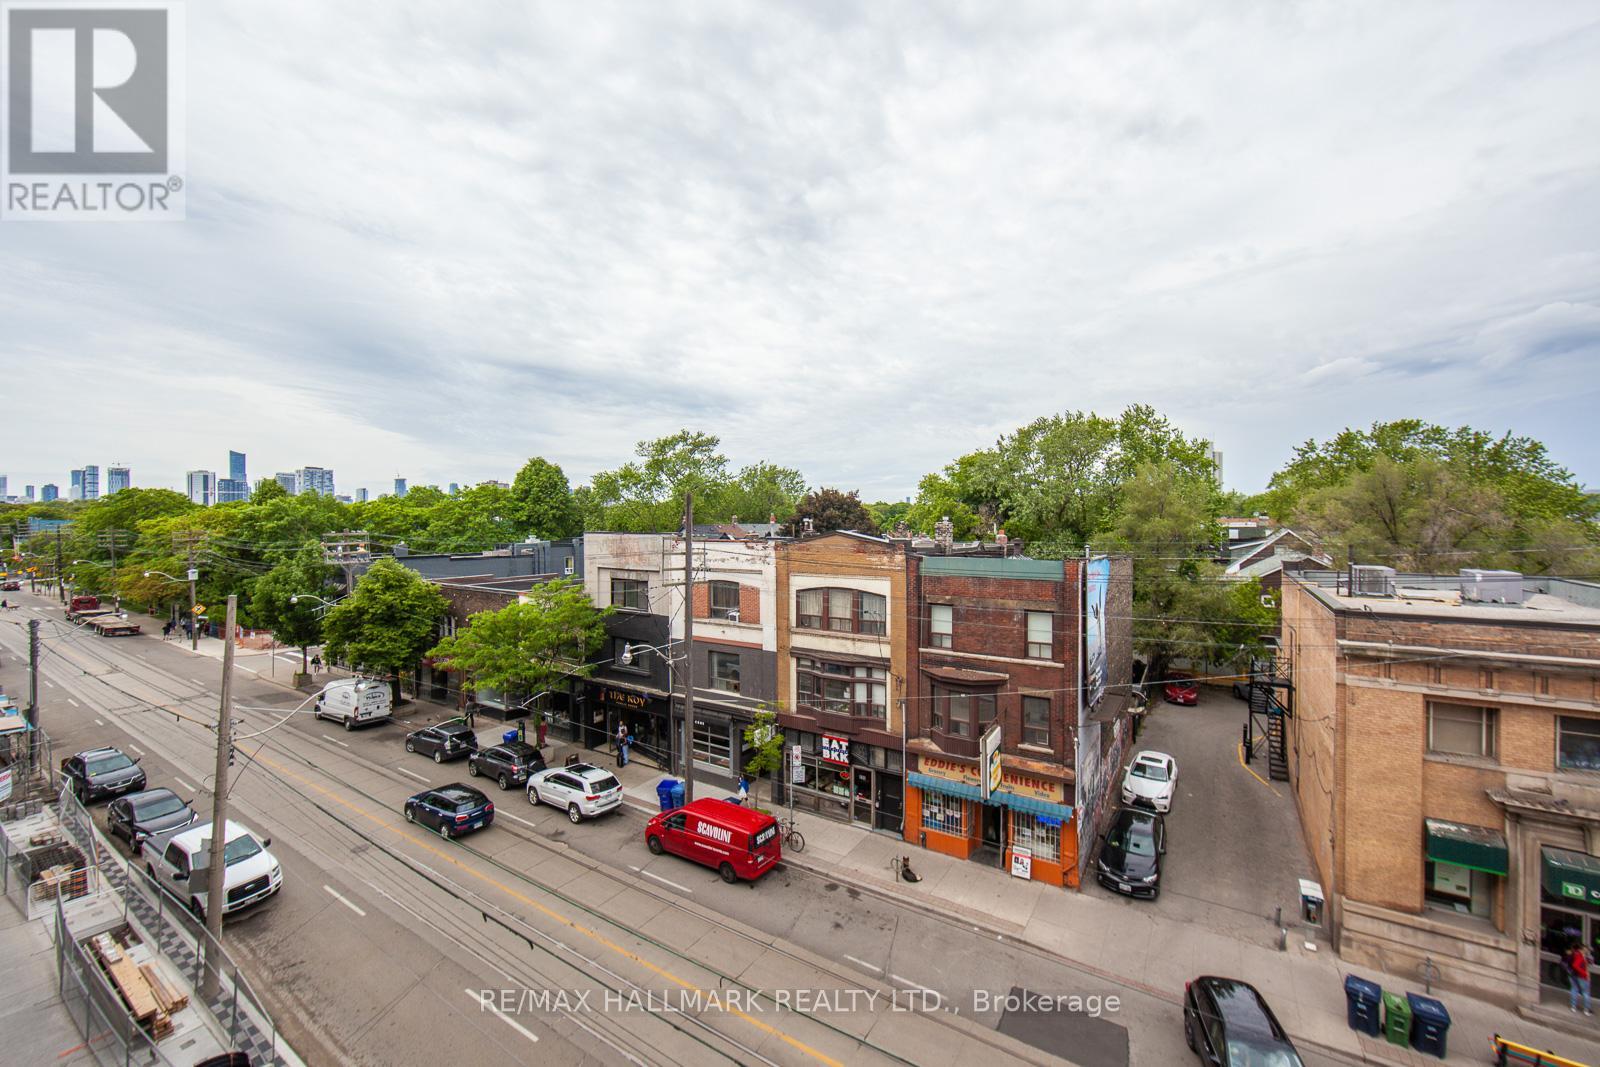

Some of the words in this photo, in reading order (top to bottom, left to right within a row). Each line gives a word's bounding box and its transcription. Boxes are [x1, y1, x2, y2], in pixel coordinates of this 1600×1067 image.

[822, 749, 849, 763] BKK
[924, 757, 966, 773] EDDIE'S
[697, 821, 733, 843] SCAVOLINI
